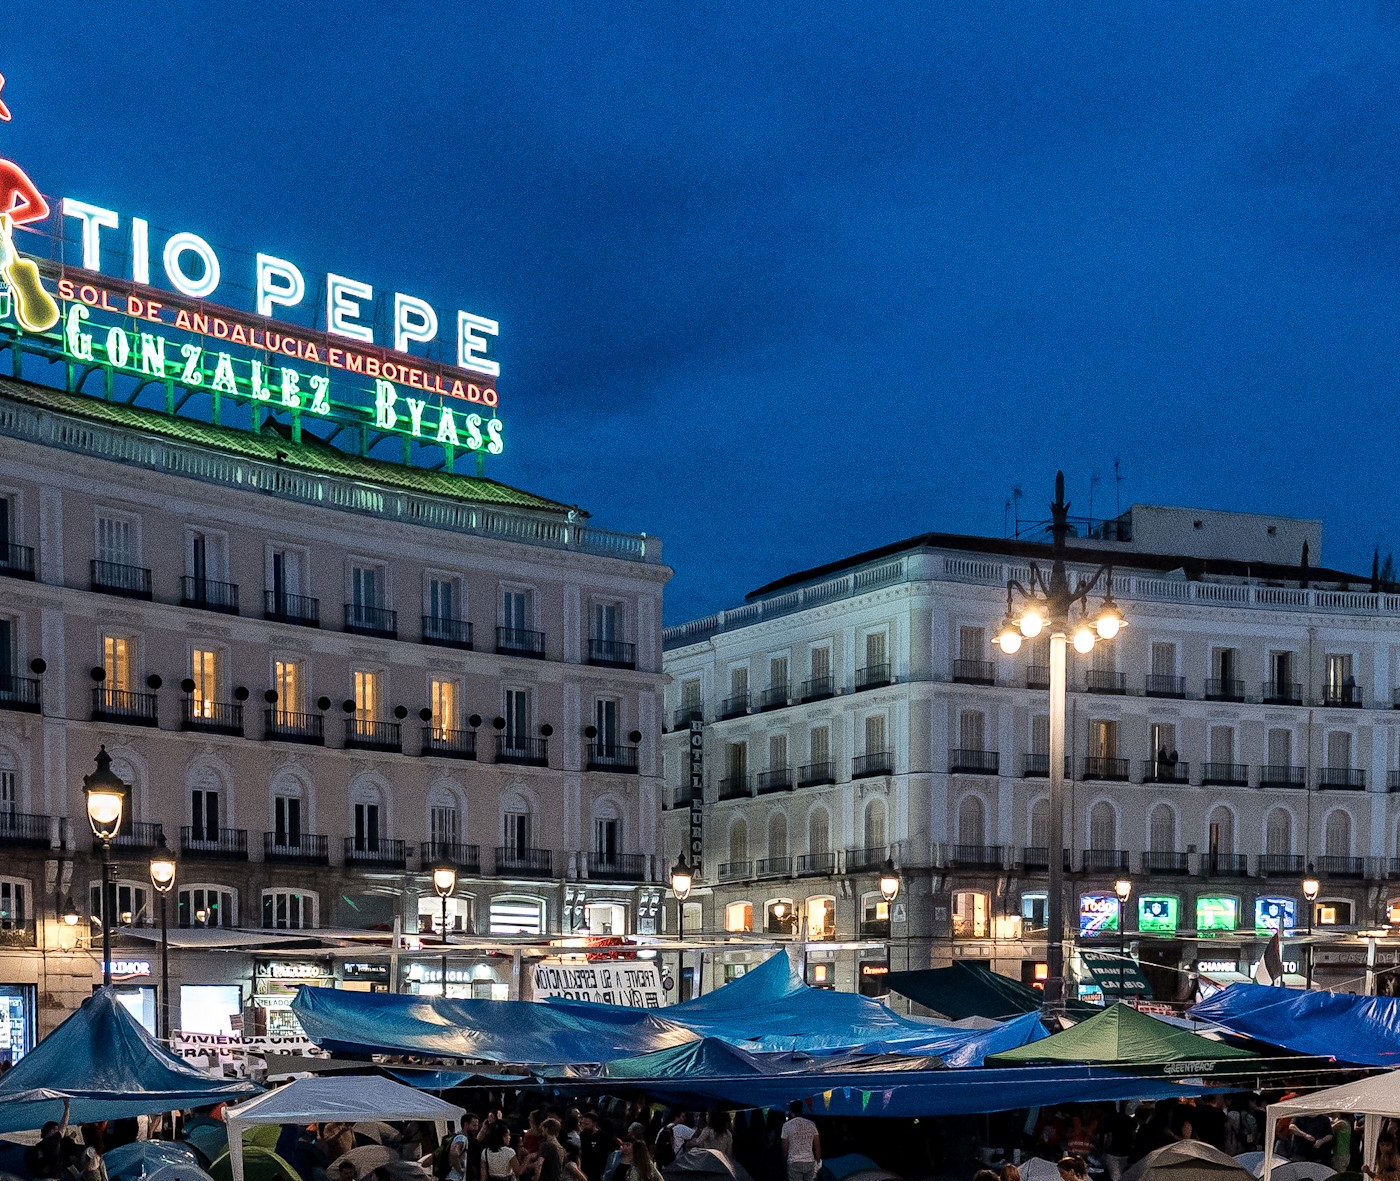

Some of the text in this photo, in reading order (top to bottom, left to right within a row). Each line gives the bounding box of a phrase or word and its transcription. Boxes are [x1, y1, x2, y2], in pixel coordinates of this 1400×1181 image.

[62, 196, 501, 377] TIO PEPE
[57, 277, 500, 408] SOL DE ANDALUCIA EMBOTELLADO
[63, 303, 505, 456] GONZALEZ BYASS
[691, 719, 703, 880] HOTEL EUROPA
[1198, 962, 1236, 972] CHANGE
[424, 971, 470, 981] SEPORA
[1101, 980, 1146, 990] CABIO
[180, 1035, 267, 1045] VIVIENDA
[1163, 1061, 1217, 1074] GREENPEACE
